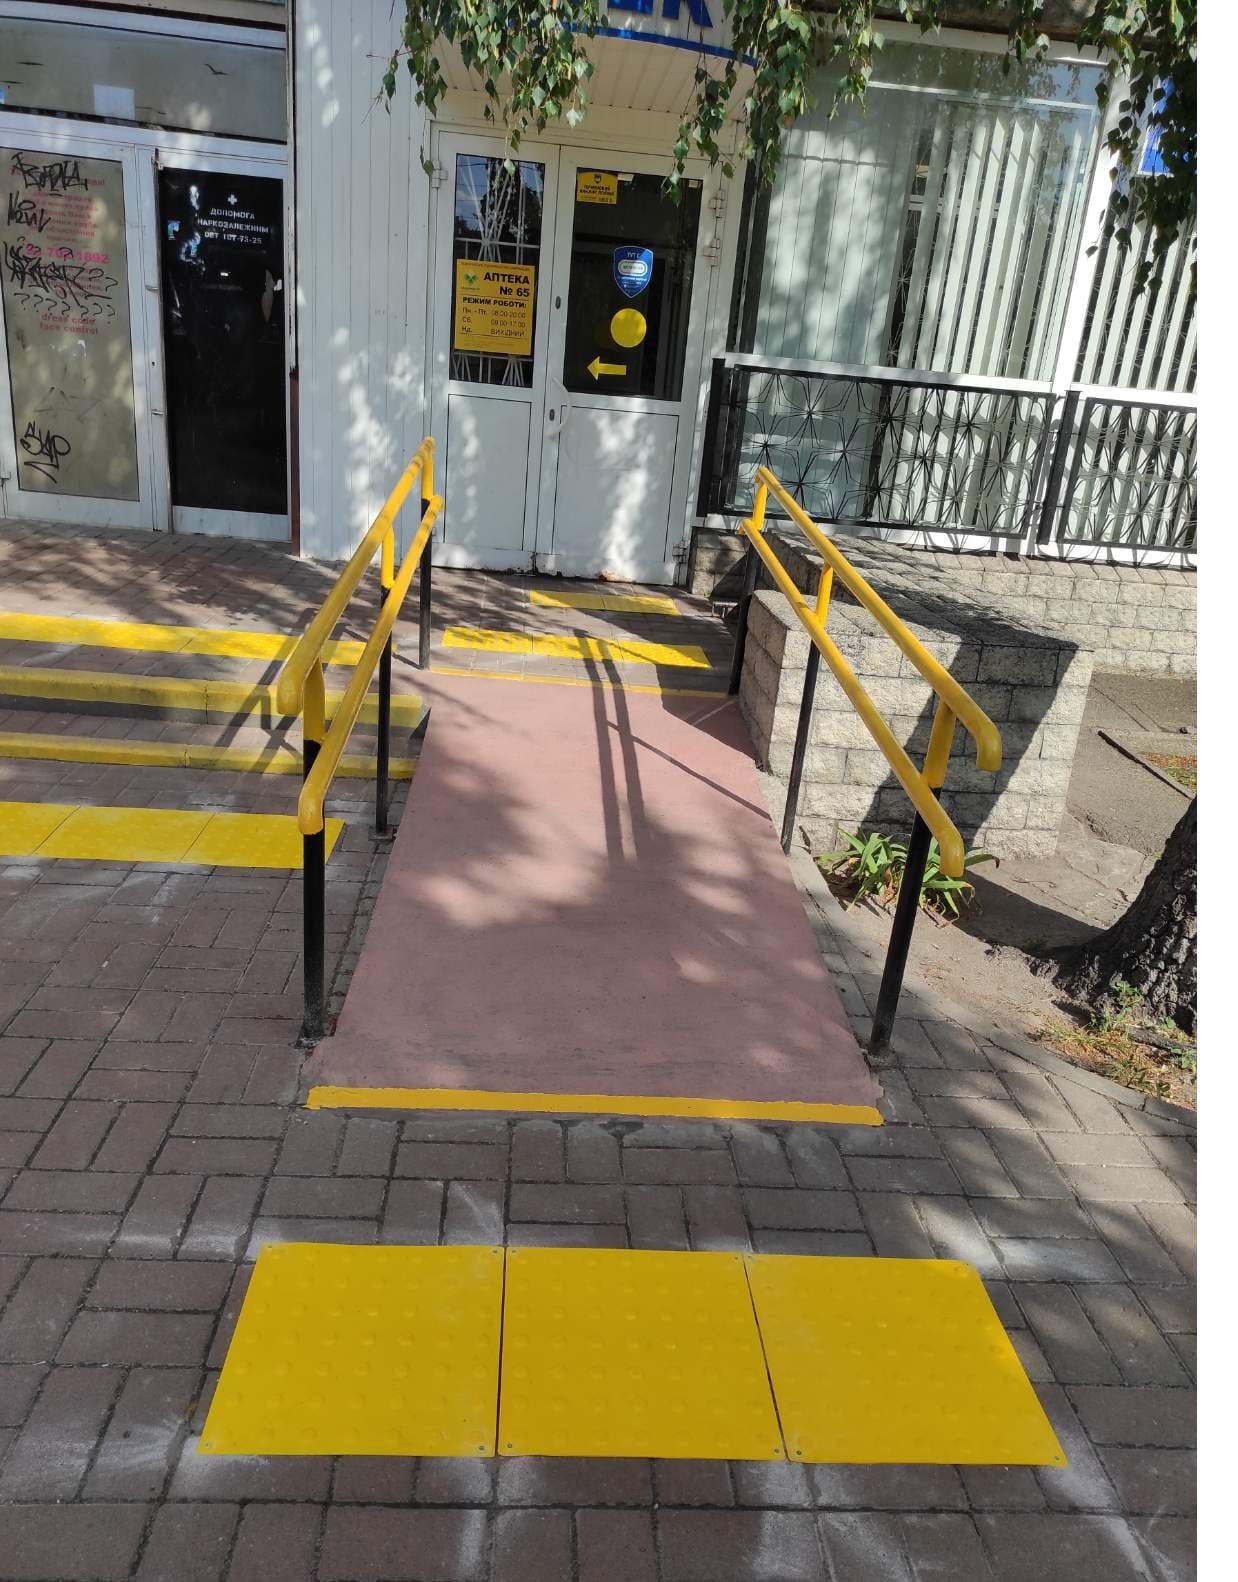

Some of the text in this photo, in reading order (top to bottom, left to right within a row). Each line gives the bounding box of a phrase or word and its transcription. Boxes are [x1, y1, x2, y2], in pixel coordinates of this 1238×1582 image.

[210, 208, 255, 220] ДОПОМОГА
[198, 218, 269, 233] НАРКОЗАЛЕЖНИМ
[483, 272, 530, 285] АПТЕКА
[500, 286, 530, 298] № 65
[462, 296, 527, 309] РЕЖИМ РОБОТИ:
[490, 328, 525, 337] ВИХІДНИЙ
